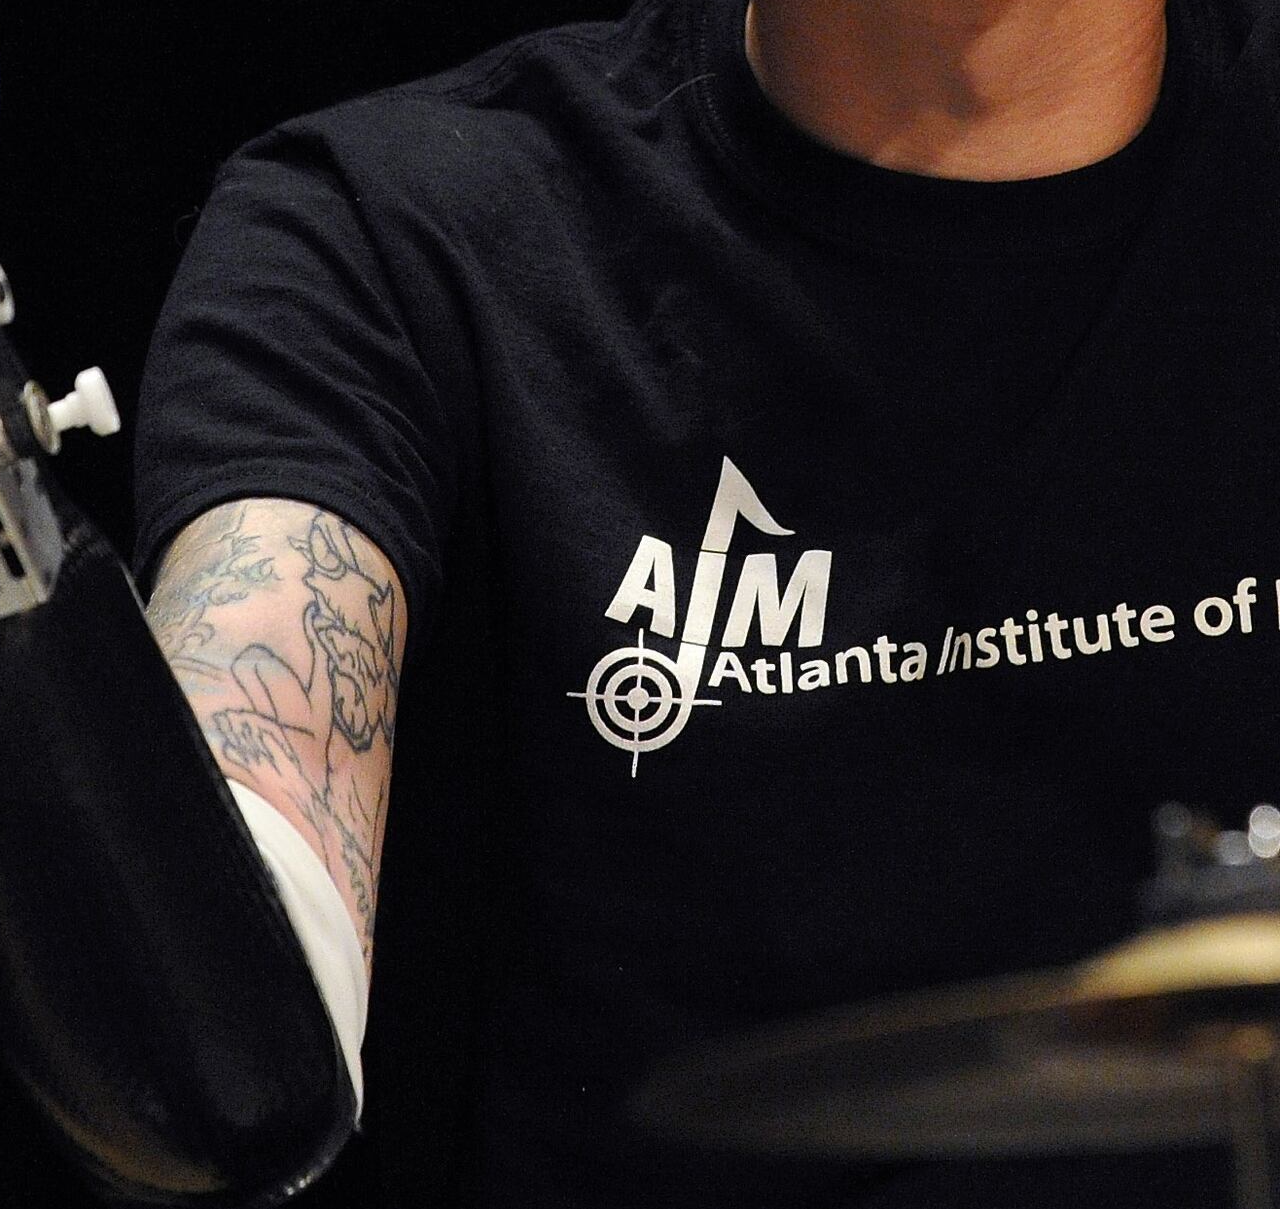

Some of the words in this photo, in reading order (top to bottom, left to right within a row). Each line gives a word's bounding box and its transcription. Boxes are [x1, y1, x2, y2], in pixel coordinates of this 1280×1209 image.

[604, 534, 833, 648] AIM
[707, 633, 929, 695] Atlanta
[936, 602, 1176, 676] Institute
[1193, 576, 1258, 638] of
